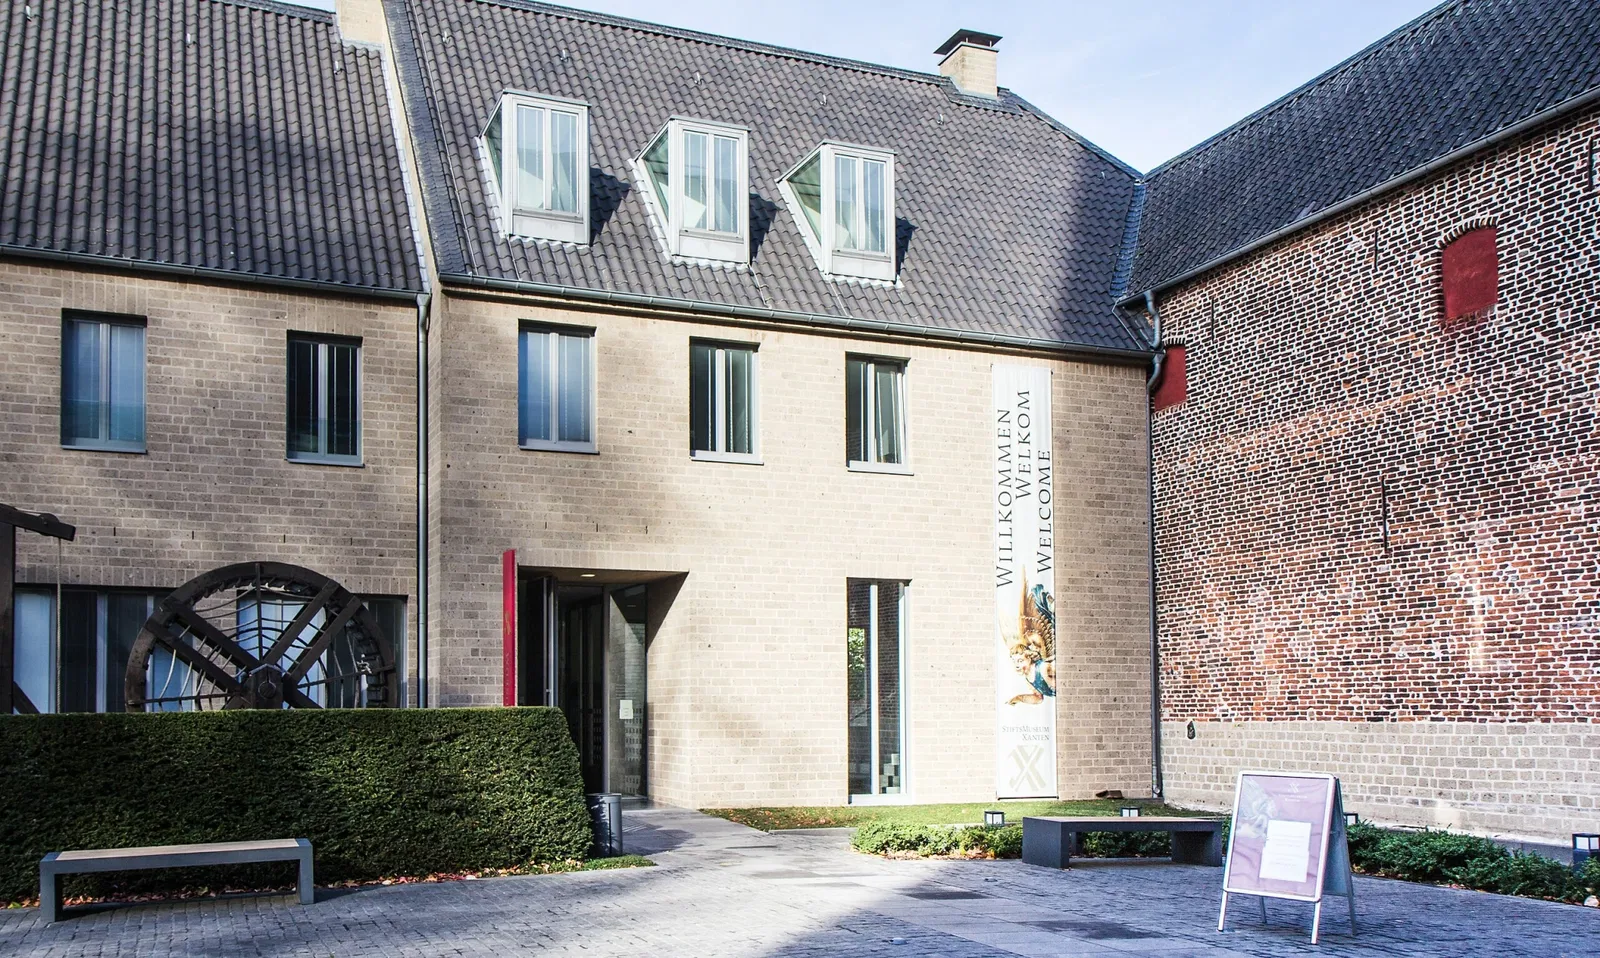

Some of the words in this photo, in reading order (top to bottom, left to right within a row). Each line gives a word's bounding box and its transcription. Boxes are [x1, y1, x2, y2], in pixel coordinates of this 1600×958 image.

[996, 409, 1013, 588] WILLKOMMEN
[1016, 390, 1031, 499] WELKOM
[1037, 450, 1052, 574] WELCOME
